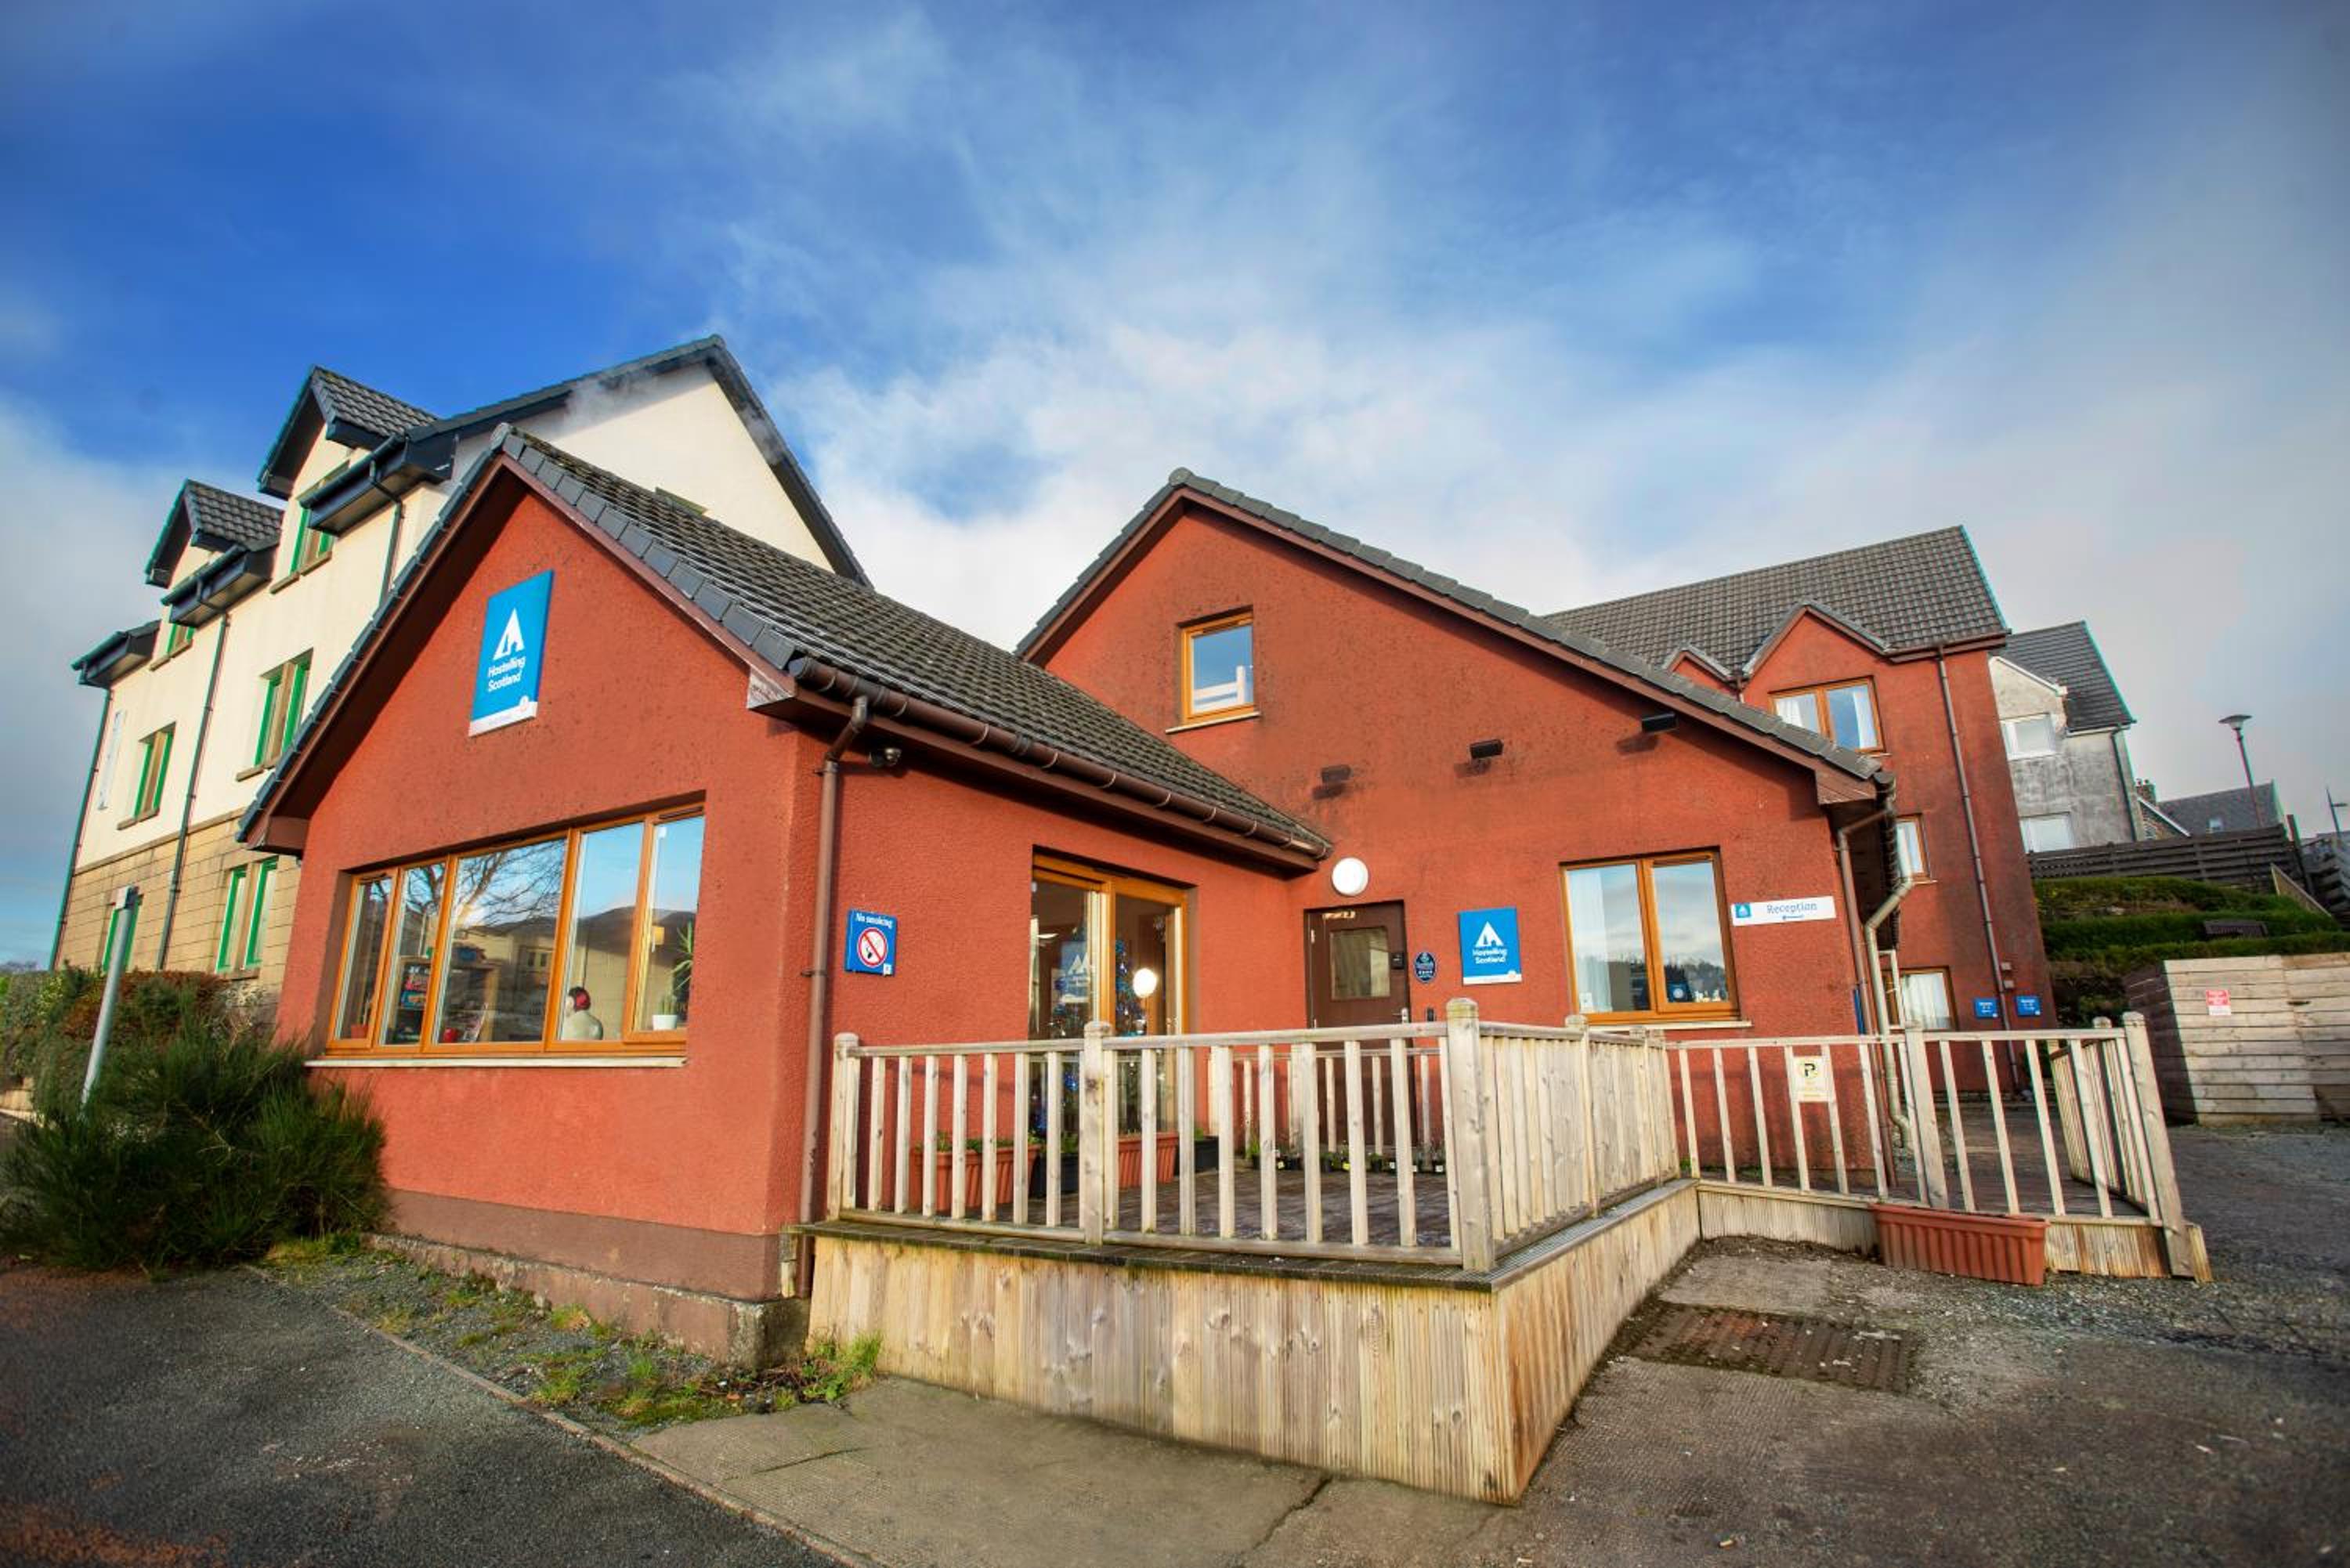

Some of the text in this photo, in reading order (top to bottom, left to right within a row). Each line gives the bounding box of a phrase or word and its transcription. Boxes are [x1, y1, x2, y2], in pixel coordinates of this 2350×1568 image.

[487, 656, 526, 677] Hostelling
[488, 670, 522, 692] Scotland
[1766, 902, 1818, 914] Reception
